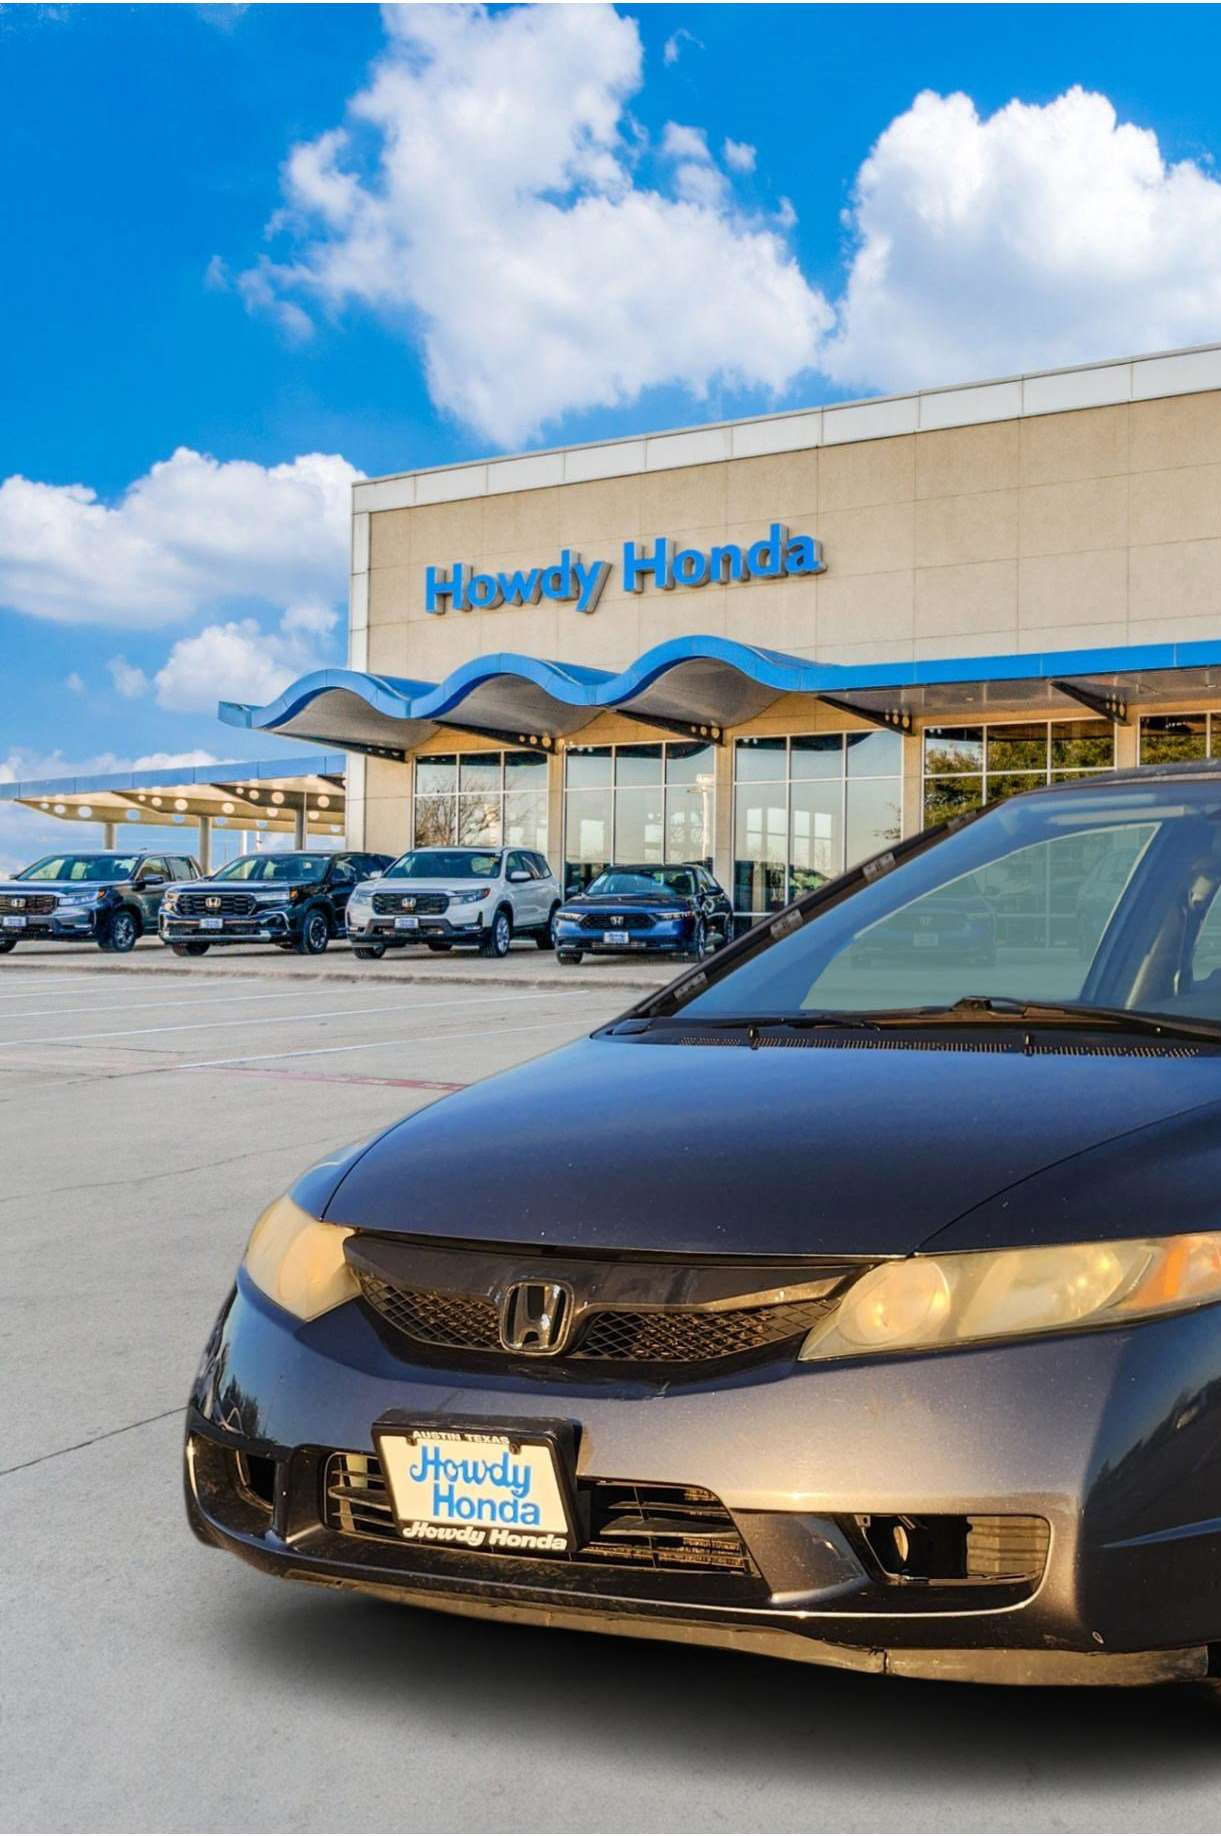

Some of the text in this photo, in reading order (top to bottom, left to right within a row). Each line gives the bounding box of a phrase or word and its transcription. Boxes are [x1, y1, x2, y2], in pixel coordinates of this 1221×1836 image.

[425, 523, 826, 614] Howdy Honda
[413, 1431, 510, 1444] AUSTIN TEXAS
[410, 1445, 532, 1498] Howdy
[433, 1484, 541, 1525] Honda
[403, 1521, 568, 1550] Howdy Honda
